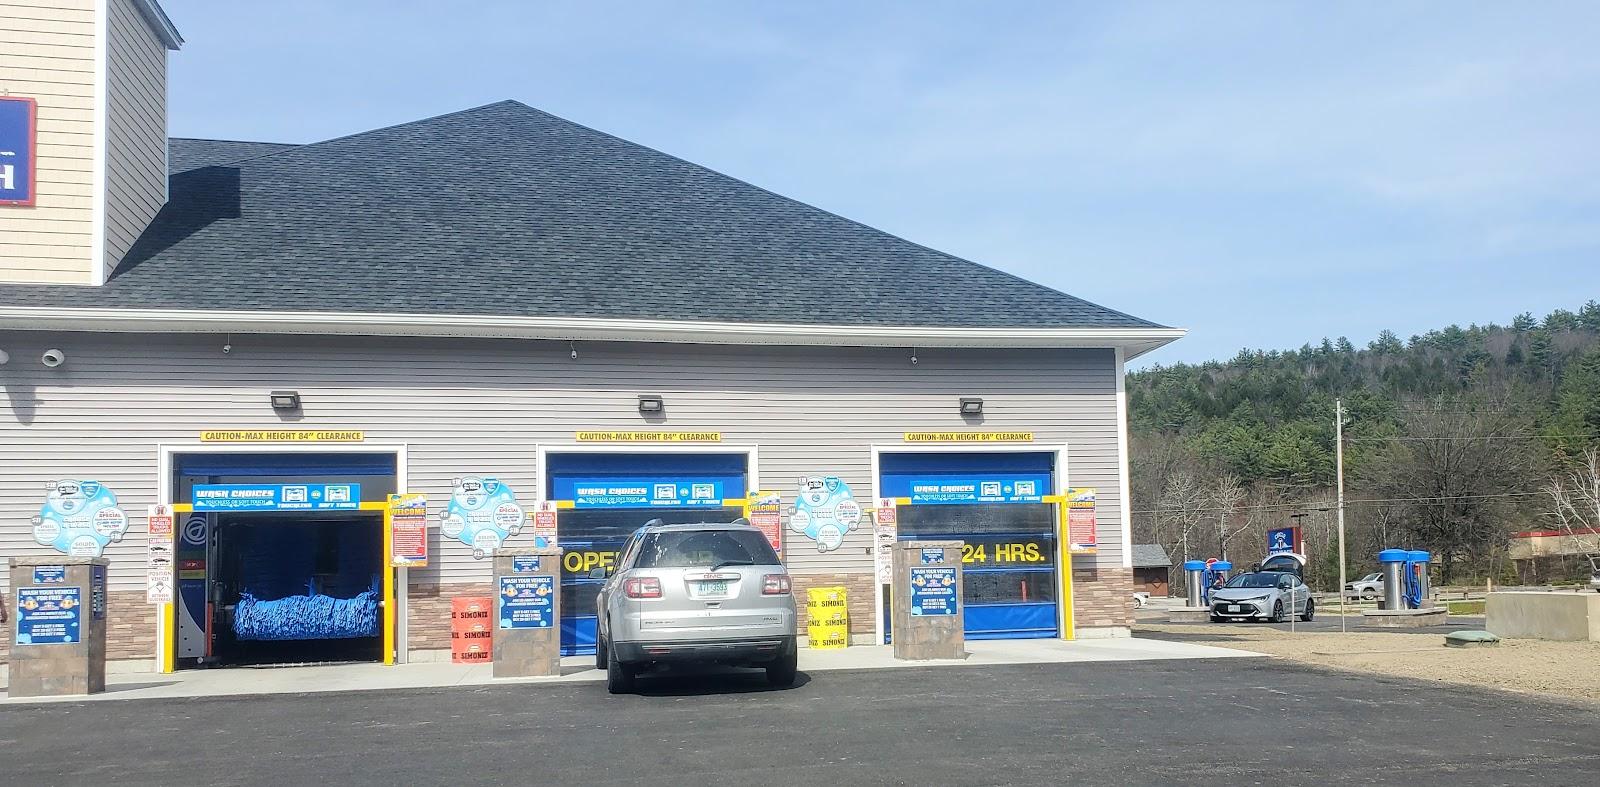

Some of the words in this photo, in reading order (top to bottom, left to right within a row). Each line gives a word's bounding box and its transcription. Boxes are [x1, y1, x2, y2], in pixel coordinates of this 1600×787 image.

[205, 432, 264, 440] CAUTION-MAX
[266, 432, 296, 440] HEIGHT
[316, 432, 361, 440] CLEARANCE
[579, 433, 632, 441] CAUTION-MAX
[634, 433, 662, 441] HEIGHT
[679, 433, 718, 441] CLEARANCE
[908, 433, 954, 441] CAUTION-MAX
[955, 433, 980, 441] HEIGHT
[995, 433, 1031, 441] CLEARANCE
[608, 487, 647, 495] CHOICES
[913, 485, 939, 493] WASH
[196, 490, 229, 498] WASH
[231, 489, 275, 497] CHOICES
[390, 508, 426, 516] WELCOME
[748, 504, 780, 512] WELCOME
[961, 544, 987, 563] 24
[995, 542, 1045, 562] HRS.
[464, 631, 490, 639] SIMONIZ
